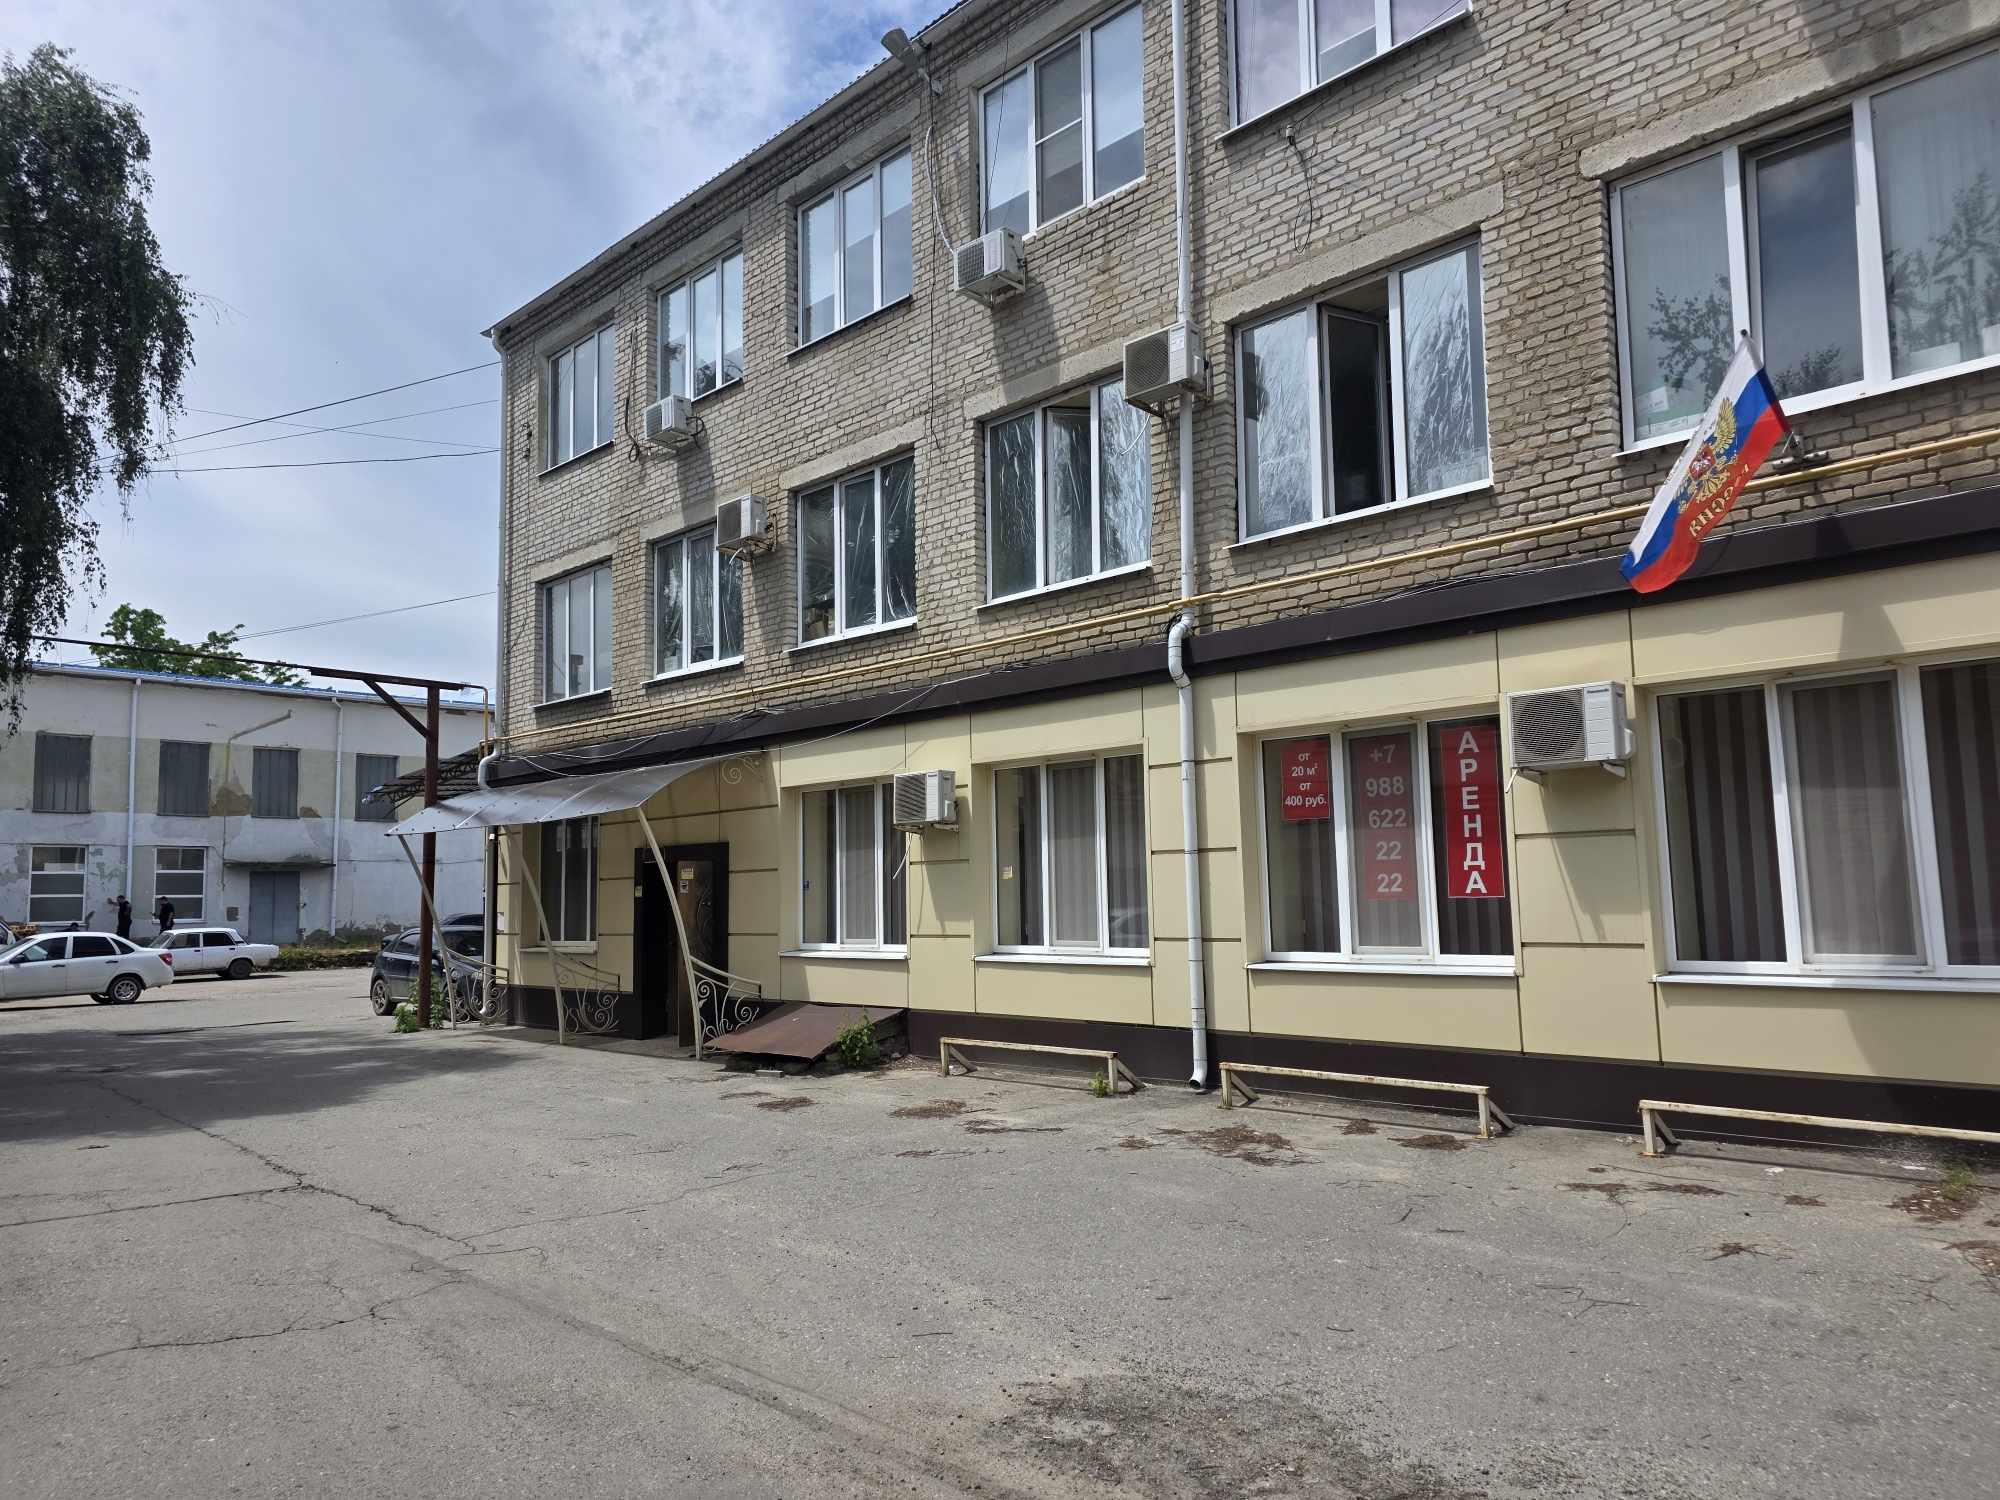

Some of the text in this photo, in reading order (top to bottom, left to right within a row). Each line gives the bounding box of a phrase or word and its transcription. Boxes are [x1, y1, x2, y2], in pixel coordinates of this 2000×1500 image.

[1370, 744, 1396, 764] +7
[1291, 766, 1304, 777] 20
[1365, 776, 1405, 797] 988
[1285, 793, 1327, 808] 400 руб.
[1368, 808, 1407, 829] 622
[1458, 731, 1487, 894] АРЕНДА
[1376, 841, 1402, 860] 22
[1377, 873, 1403, 893] 22
